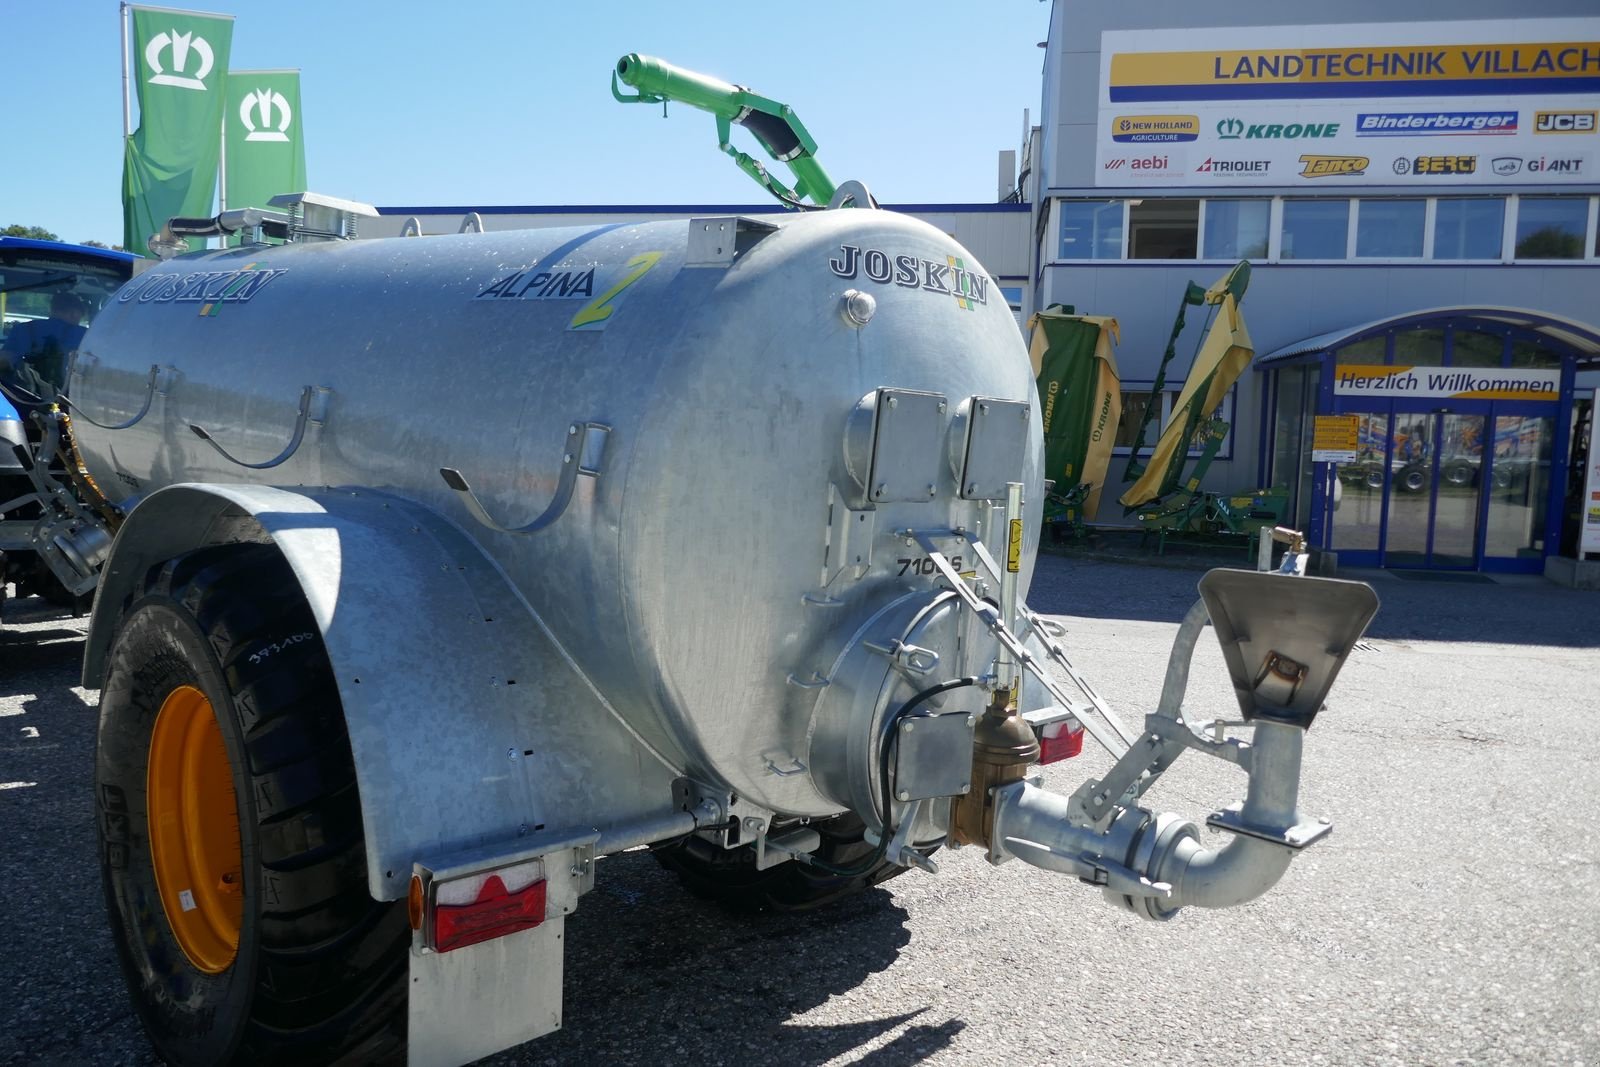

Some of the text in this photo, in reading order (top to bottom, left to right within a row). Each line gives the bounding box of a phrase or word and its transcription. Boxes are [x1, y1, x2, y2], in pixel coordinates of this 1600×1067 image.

[1214, 47, 1600, 79] LANDTECHNIK VILLACH
[1132, 121, 1192, 130] NEW HOLLAND
[1246, 123, 1340, 139] KRONE
[1361, 115, 1514, 129] Binderberger
[1538, 114, 1593, 131] JCB
[1131, 156, 1168, 169] aebi
[1212, 161, 1271, 172] TRIOLIET
[1299, 155, 1370, 176] Tanco
[829, 244, 988, 304] JOSKIN
[118, 269, 289, 304] JOSKIN
[476, 252, 664, 329] ALPINA 2
[1340, 372, 1554, 393] Herzlich Willkommen
[1098, 392, 1112, 431] KRONE
